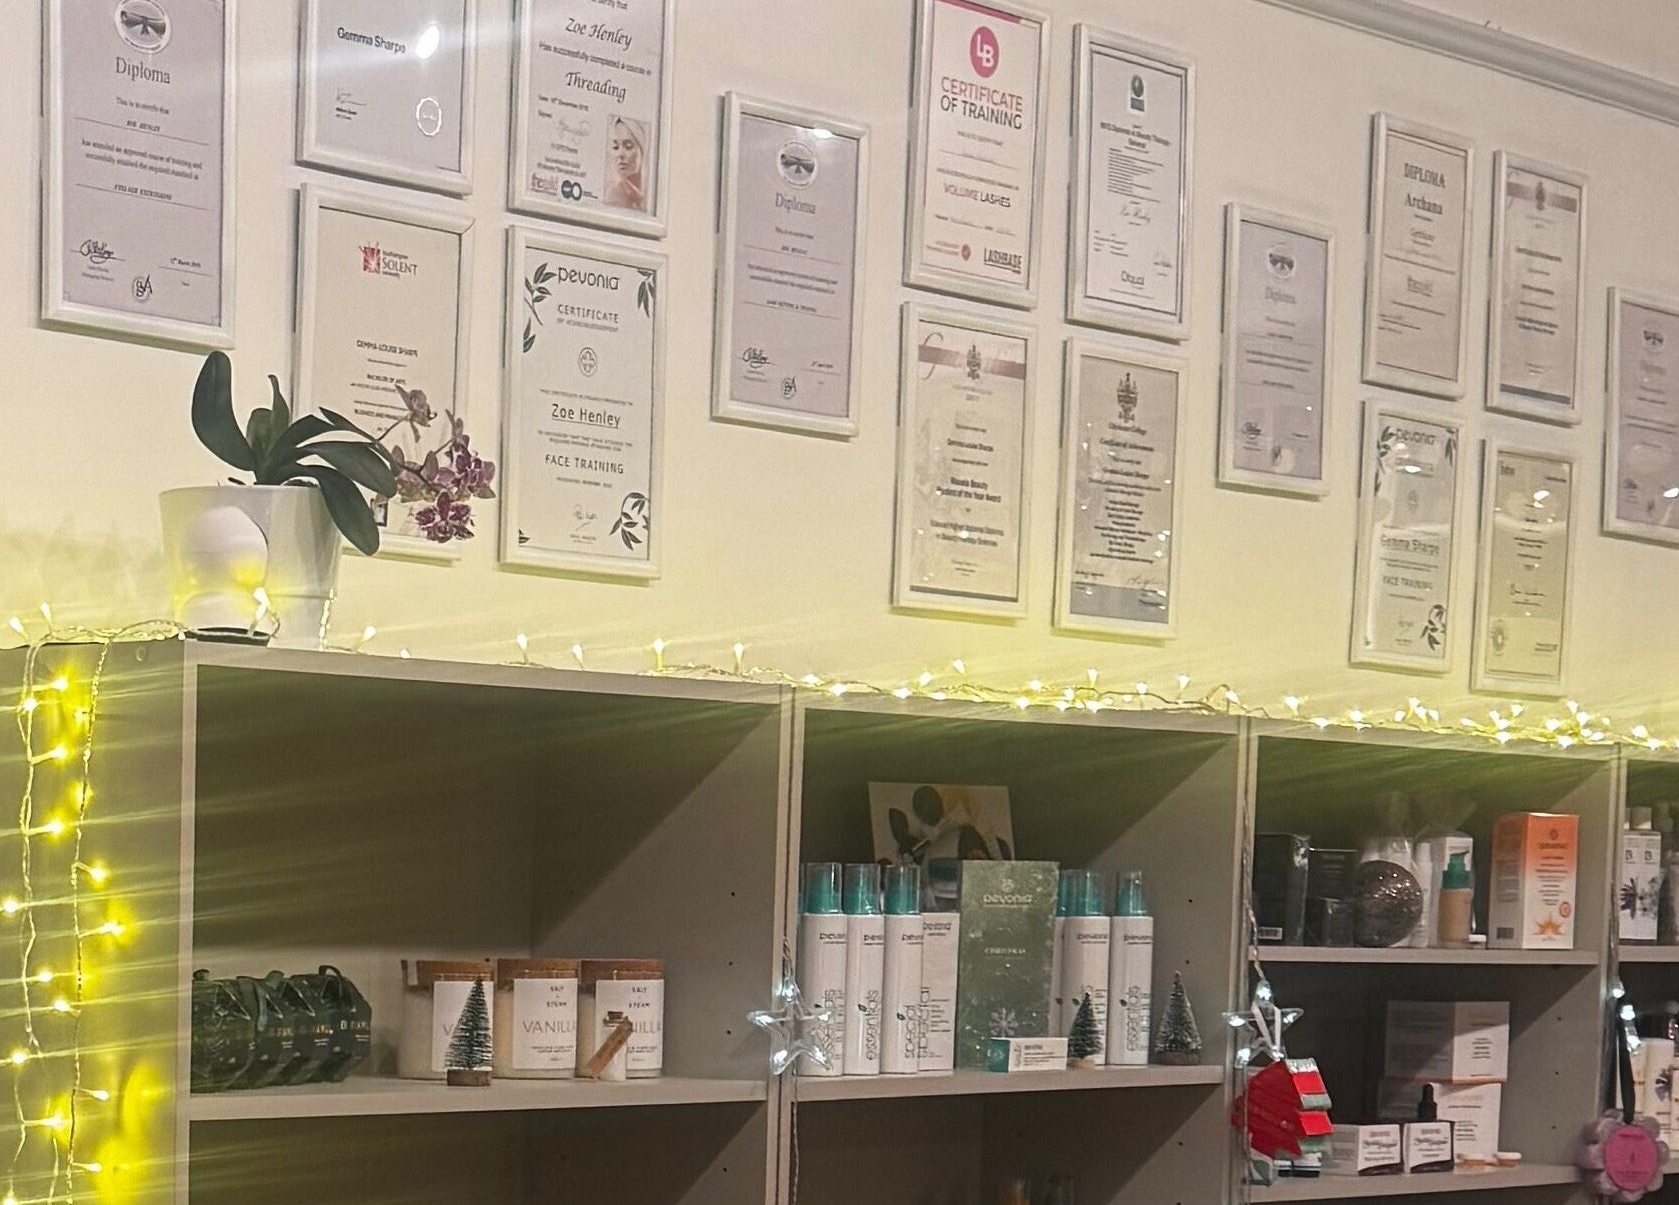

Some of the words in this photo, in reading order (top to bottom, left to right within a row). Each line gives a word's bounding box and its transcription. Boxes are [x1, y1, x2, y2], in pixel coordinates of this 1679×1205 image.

[337, 27, 373, 46] Gemma
[565, 18, 587, 35] Zoe
[589, 23, 632, 52] Henley
[116, 57, 170, 84] Diploma
[565, 71, 626, 104] Threading
[941, 76, 1023, 113] CERTIFICATE
[940, 95, 958, 112] OF
[961, 99, 1022, 130] TRAINING
[775, 191, 817, 215] Diploma
[382, 255, 418, 277] SOLENT
[558, 267, 620, 291] pevonia
[557, 303, 620, 324] CERTIFICATE
[551, 403, 575, 420] Zoe
[579, 407, 621, 427] Henley
[545, 453, 570, 468] FACE
[574, 457, 624, 474] TRAINING
[983, 894, 1032, 905] pevonia
